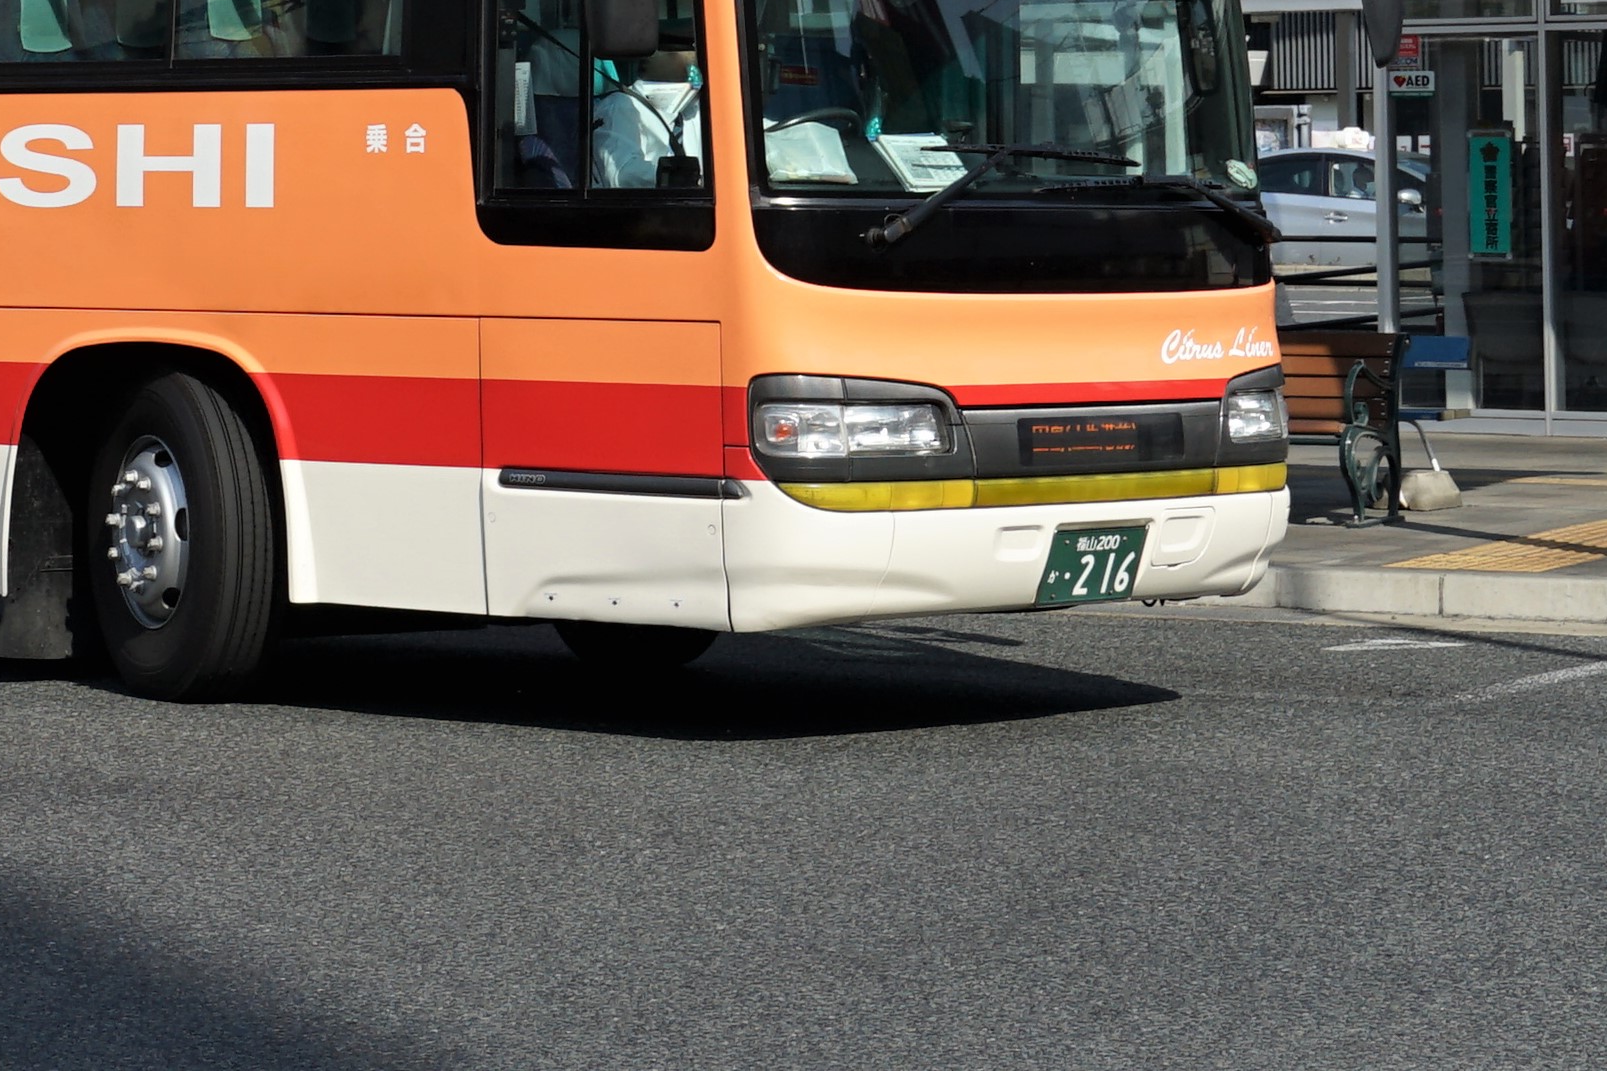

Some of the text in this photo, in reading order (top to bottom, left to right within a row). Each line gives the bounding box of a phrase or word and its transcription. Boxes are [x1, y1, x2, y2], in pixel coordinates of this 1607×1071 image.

[1406, 75, 1430, 87] AED
[1161, 326, 1274, 364] Citrus Liner
